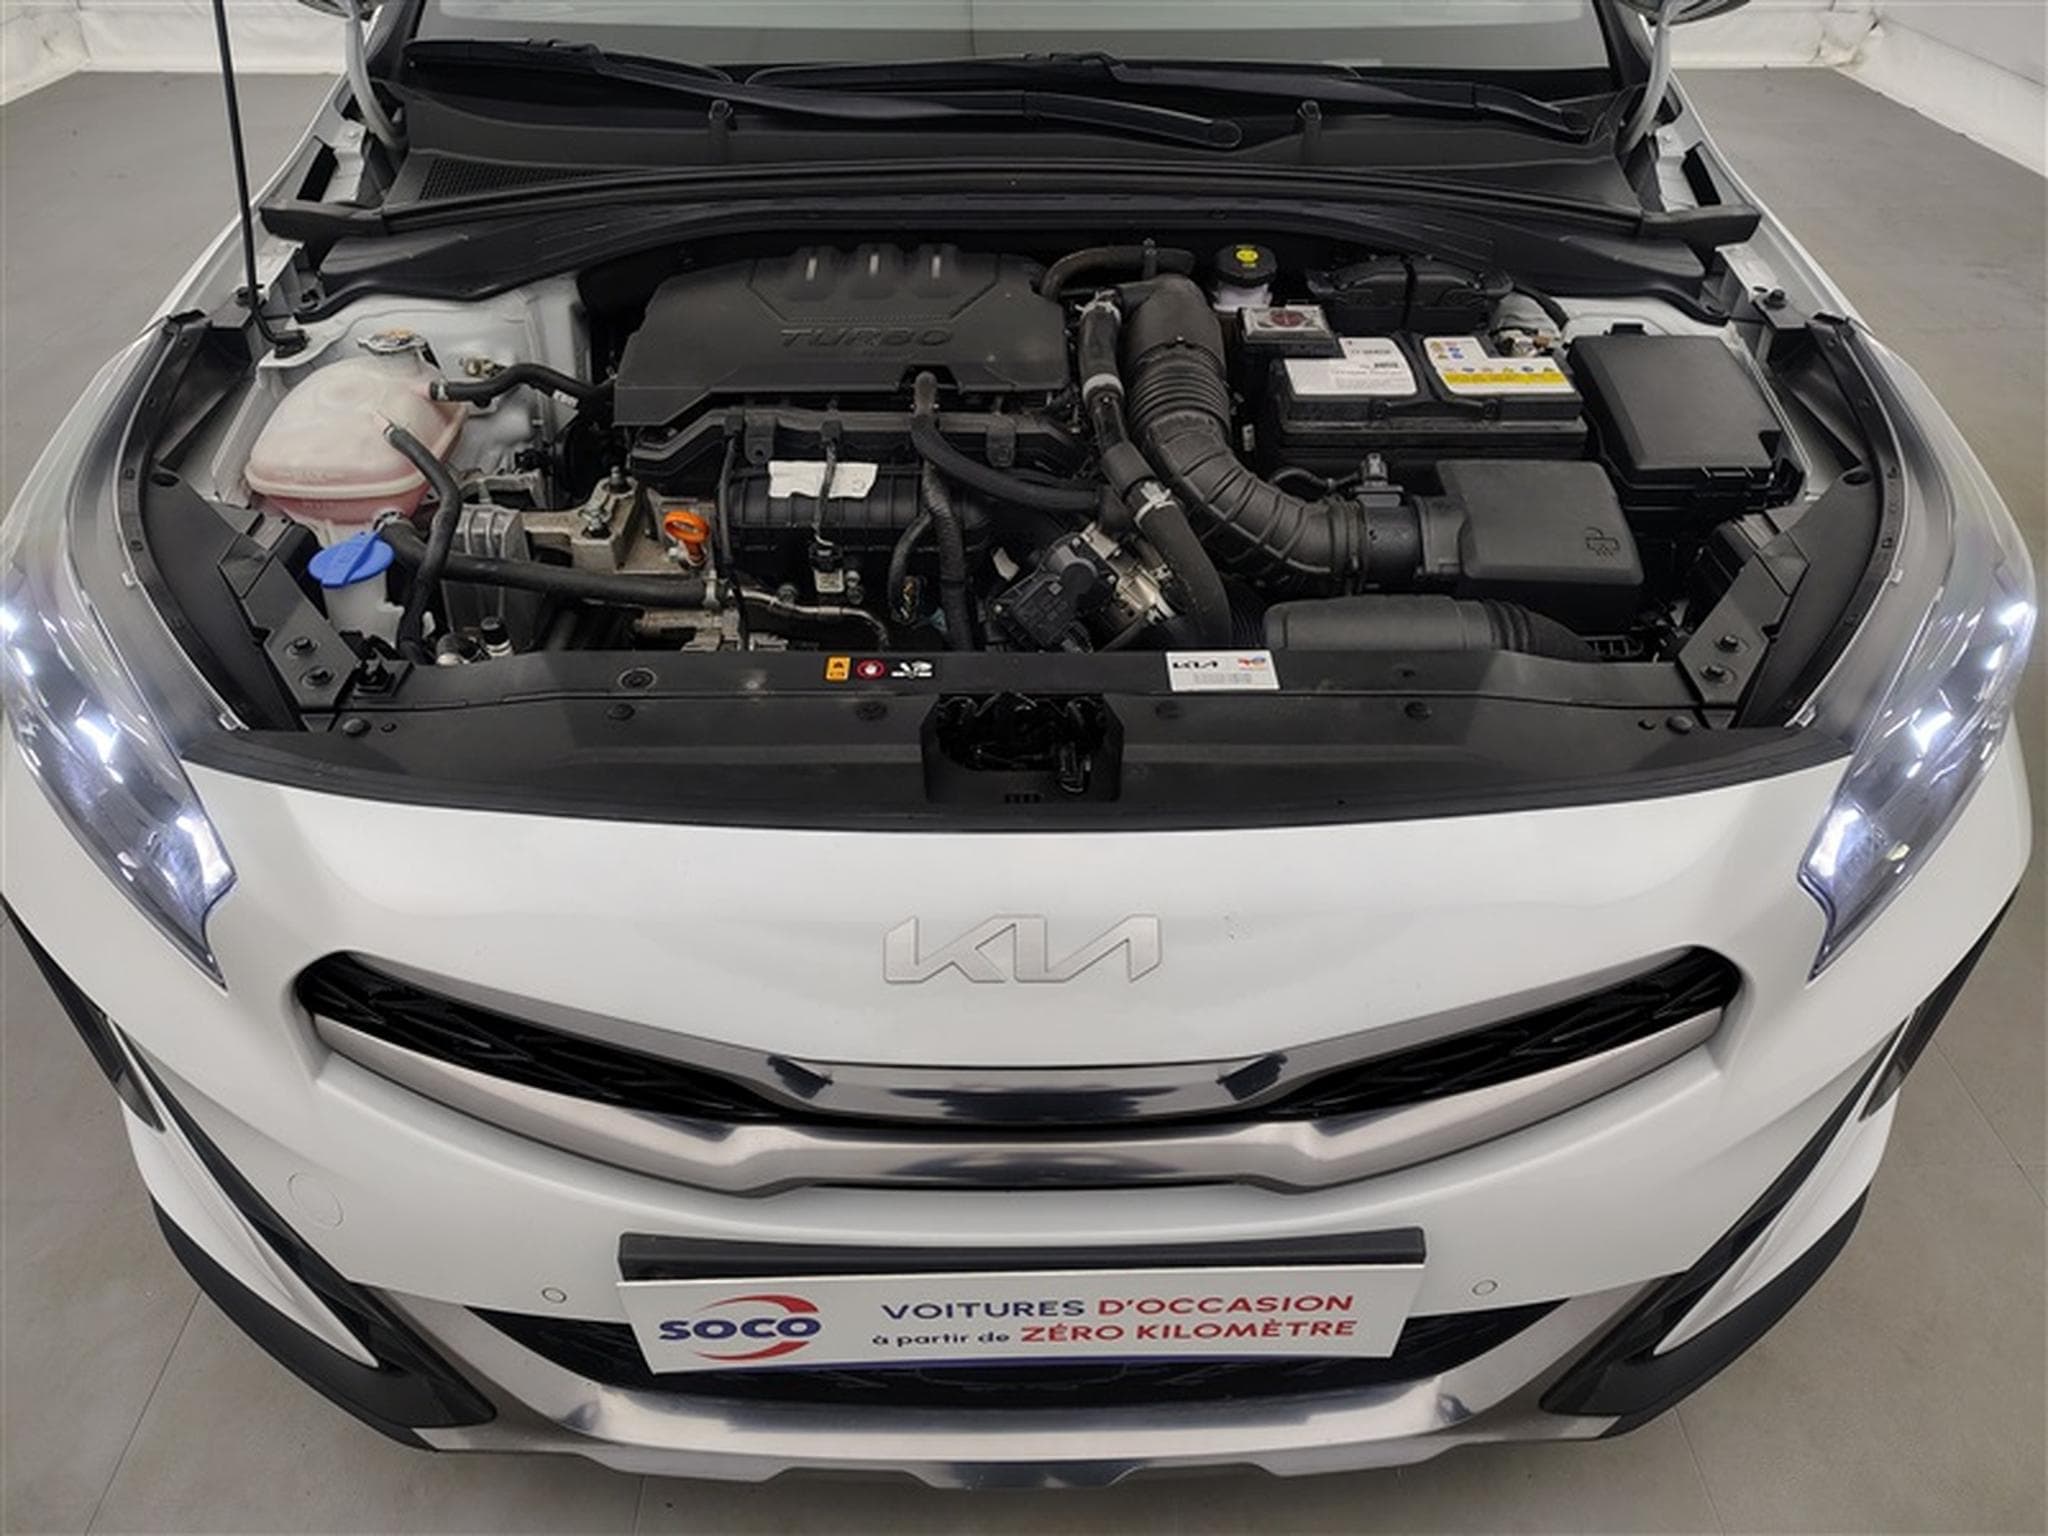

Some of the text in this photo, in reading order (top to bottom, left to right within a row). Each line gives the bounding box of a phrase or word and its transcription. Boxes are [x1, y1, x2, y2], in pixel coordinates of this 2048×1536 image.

[780, 327, 953, 347] TURBO
[883, 913, 1163, 984] KIA
[881, 1295, 1353, 1319] VOITURES D'OCCASION
[658, 1317, 822, 1341] SOCO
[872, 1318, 1358, 1348] à partir de ZÉRO KILOMÈTRE
